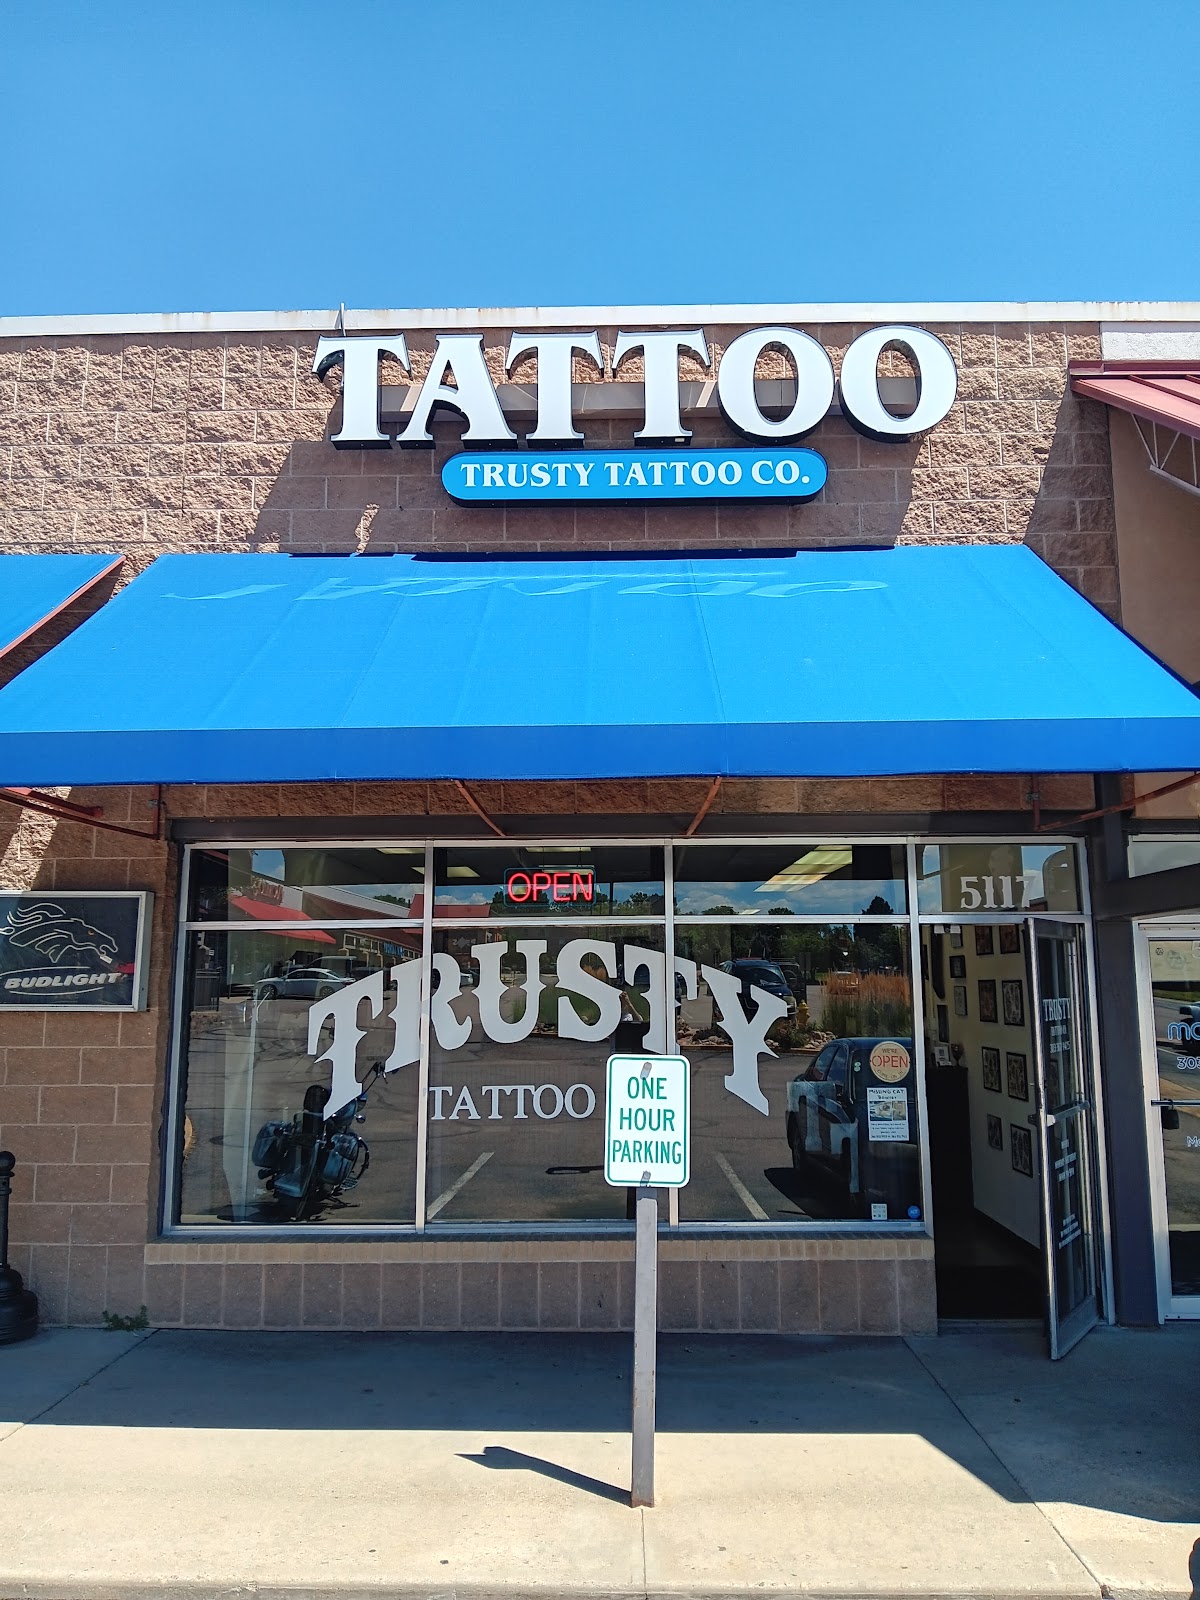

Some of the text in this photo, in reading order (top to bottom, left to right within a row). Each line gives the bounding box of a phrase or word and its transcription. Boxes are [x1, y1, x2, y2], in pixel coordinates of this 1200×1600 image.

[311, 325, 958, 444] TATTOO
[460, 460, 811, 487] TRUSTY TATTOO CO.
[507, 872, 593, 902] OPEN
[960, 875, 1036, 909] 5117
[1042, 997, 1071, 1021] TRUSTY
[307, 938, 788, 1121] TRUSTY
[871, 1055, 909, 1068] OPEN
[429, 1083, 596, 1120] TATTOO
[627, 1076, 667, 1100] ONE
[619, 1107, 675, 1131] HOUR
[612, 1140, 682, 1164] PARKING
